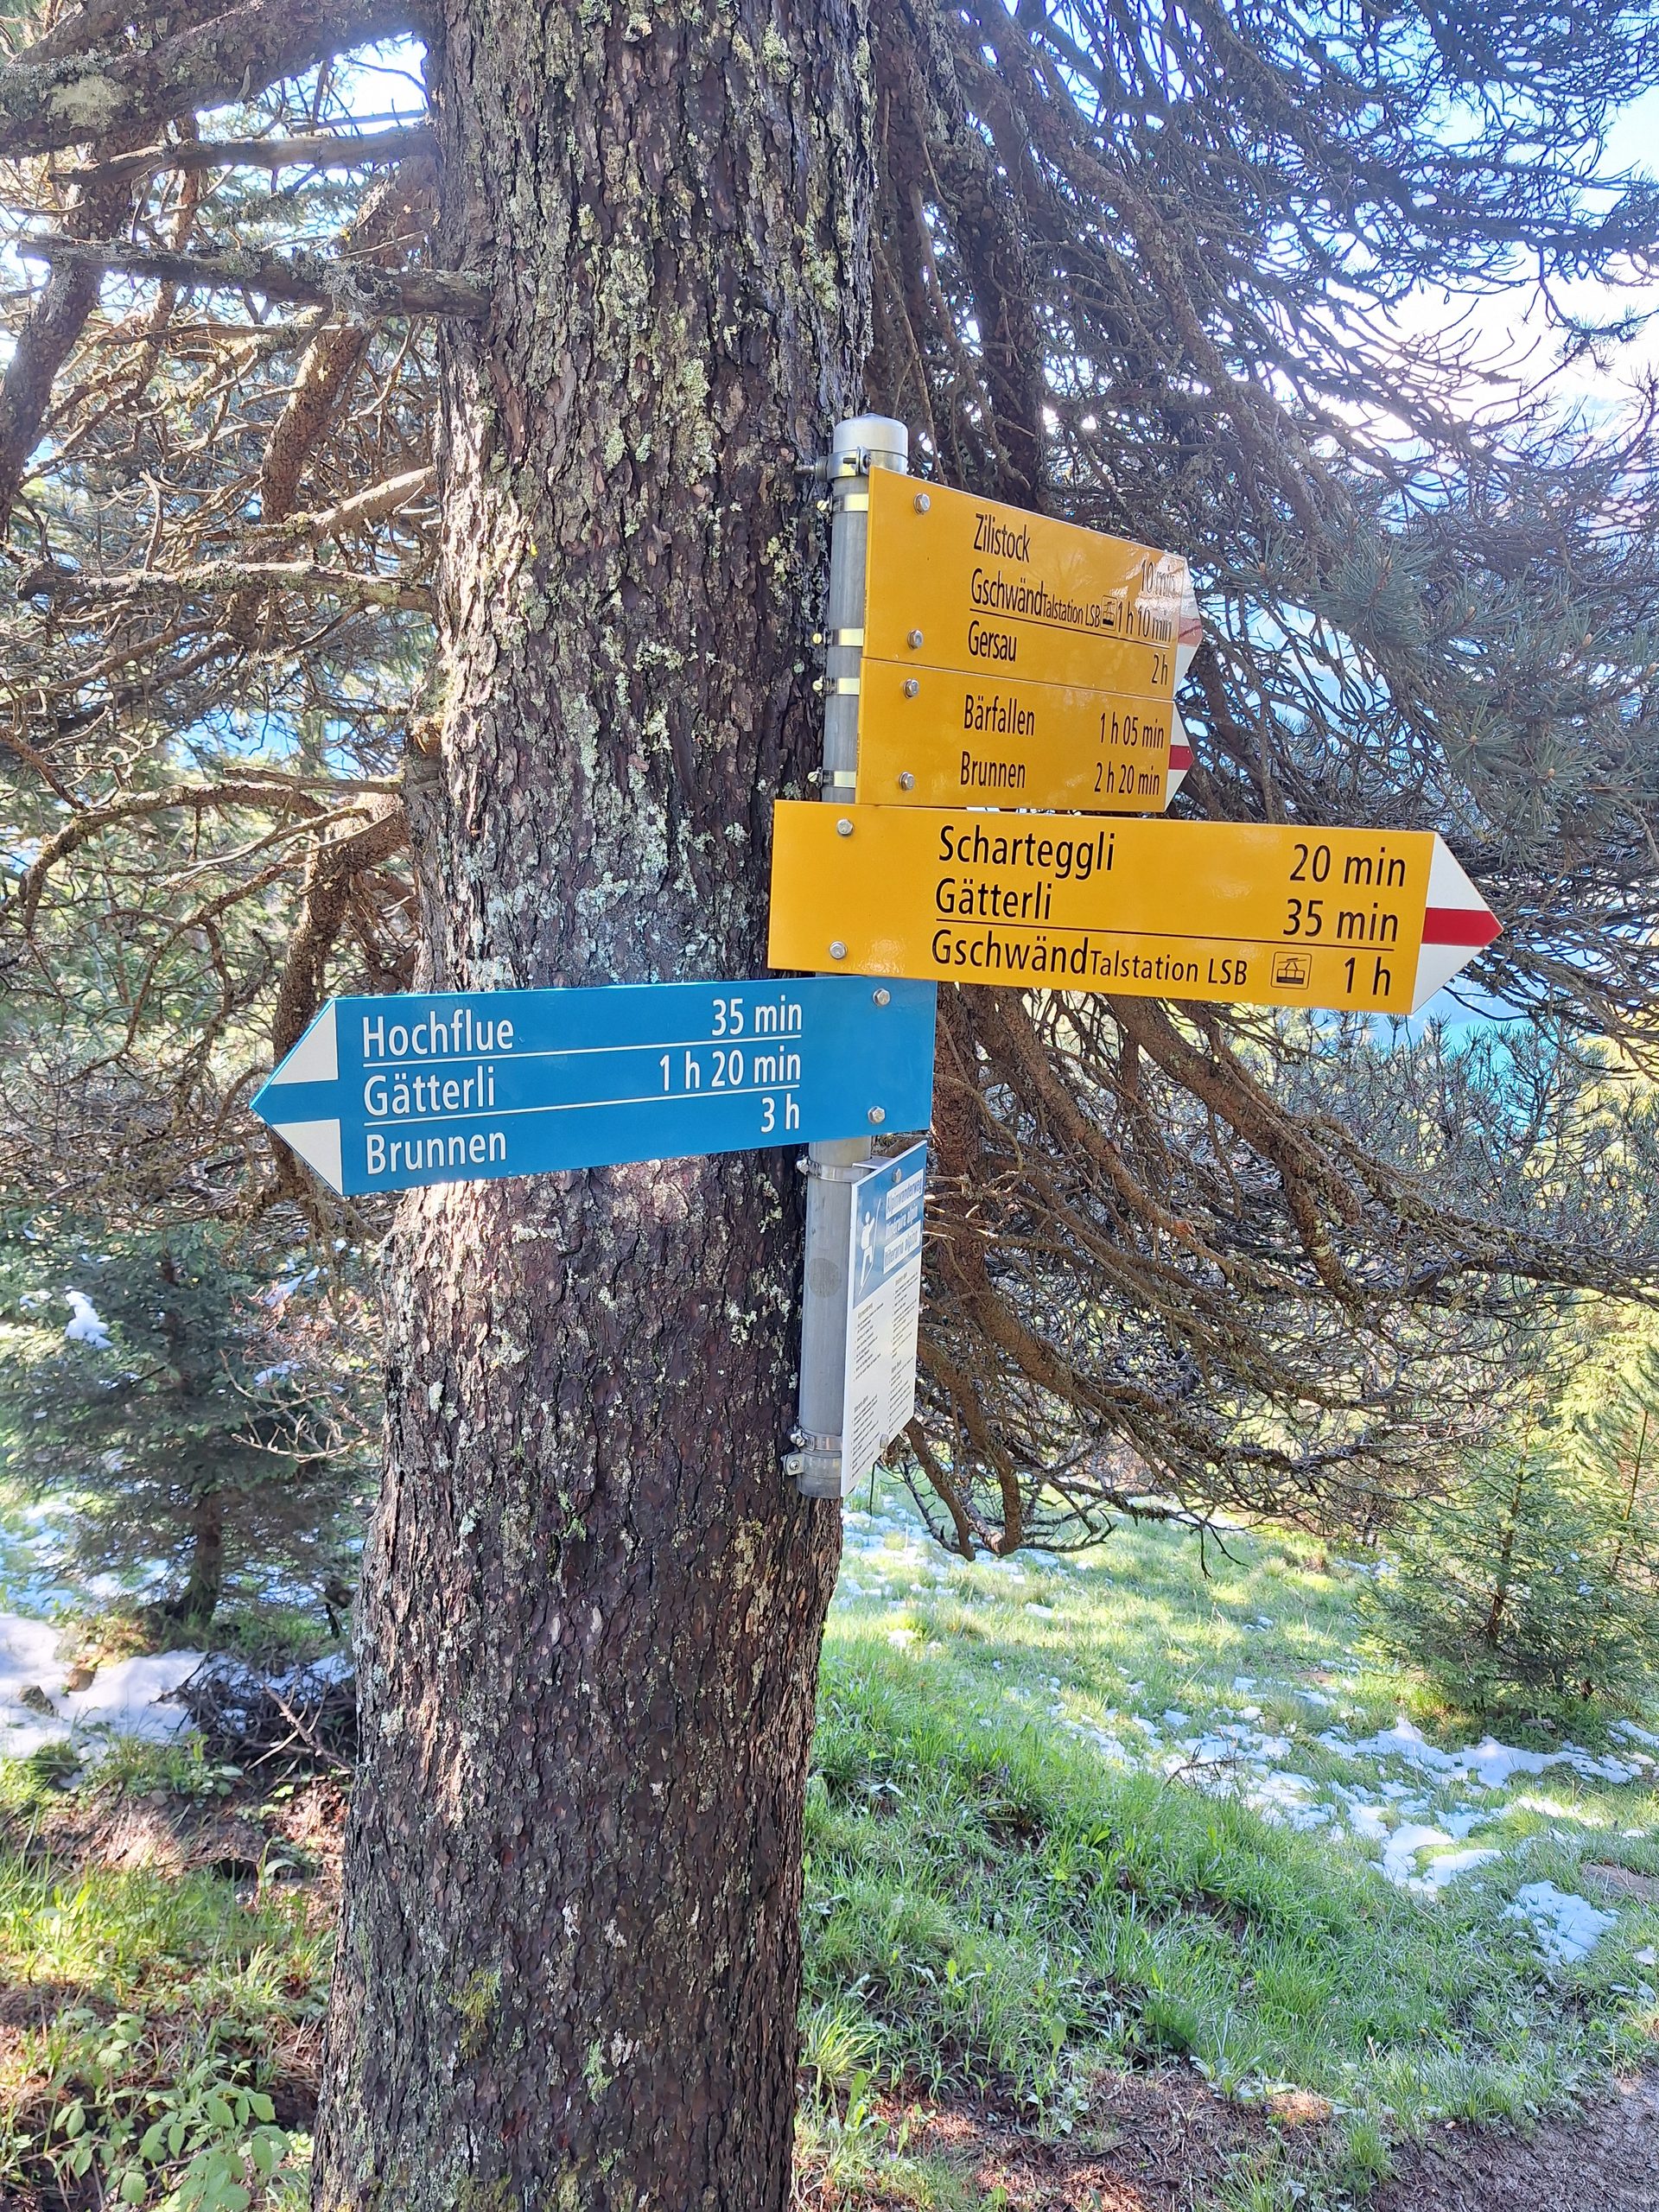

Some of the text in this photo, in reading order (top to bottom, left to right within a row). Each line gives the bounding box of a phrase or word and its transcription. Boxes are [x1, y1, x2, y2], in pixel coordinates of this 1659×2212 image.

[973, 513, 1030, 563] Zilistock
[1141, 560, 1154, 594] 10
[971, 568, 1172, 643] Gschwänd Talstation LSB 1 h 10 min
[968, 621, 1168, 685] Gersau 2 h
[963, 694, 1164, 749] Bärfallen 1 h 05 min
[960, 751, 1160, 796] Brunnen 2 h 20 min
[938, 825, 1406, 887] Scharteggli 20 min
[936, 877, 1397, 943] Gätterli 35 min
[931, 928, 1390, 996] Gschwänd Talstation LSB 1 h
[363, 994, 803, 1059] Hochflue 35 min
[363, 1046, 801, 1116] Gätterli 1 h 20 min
[365, 1093, 799, 1174] Brunnen 3 h
